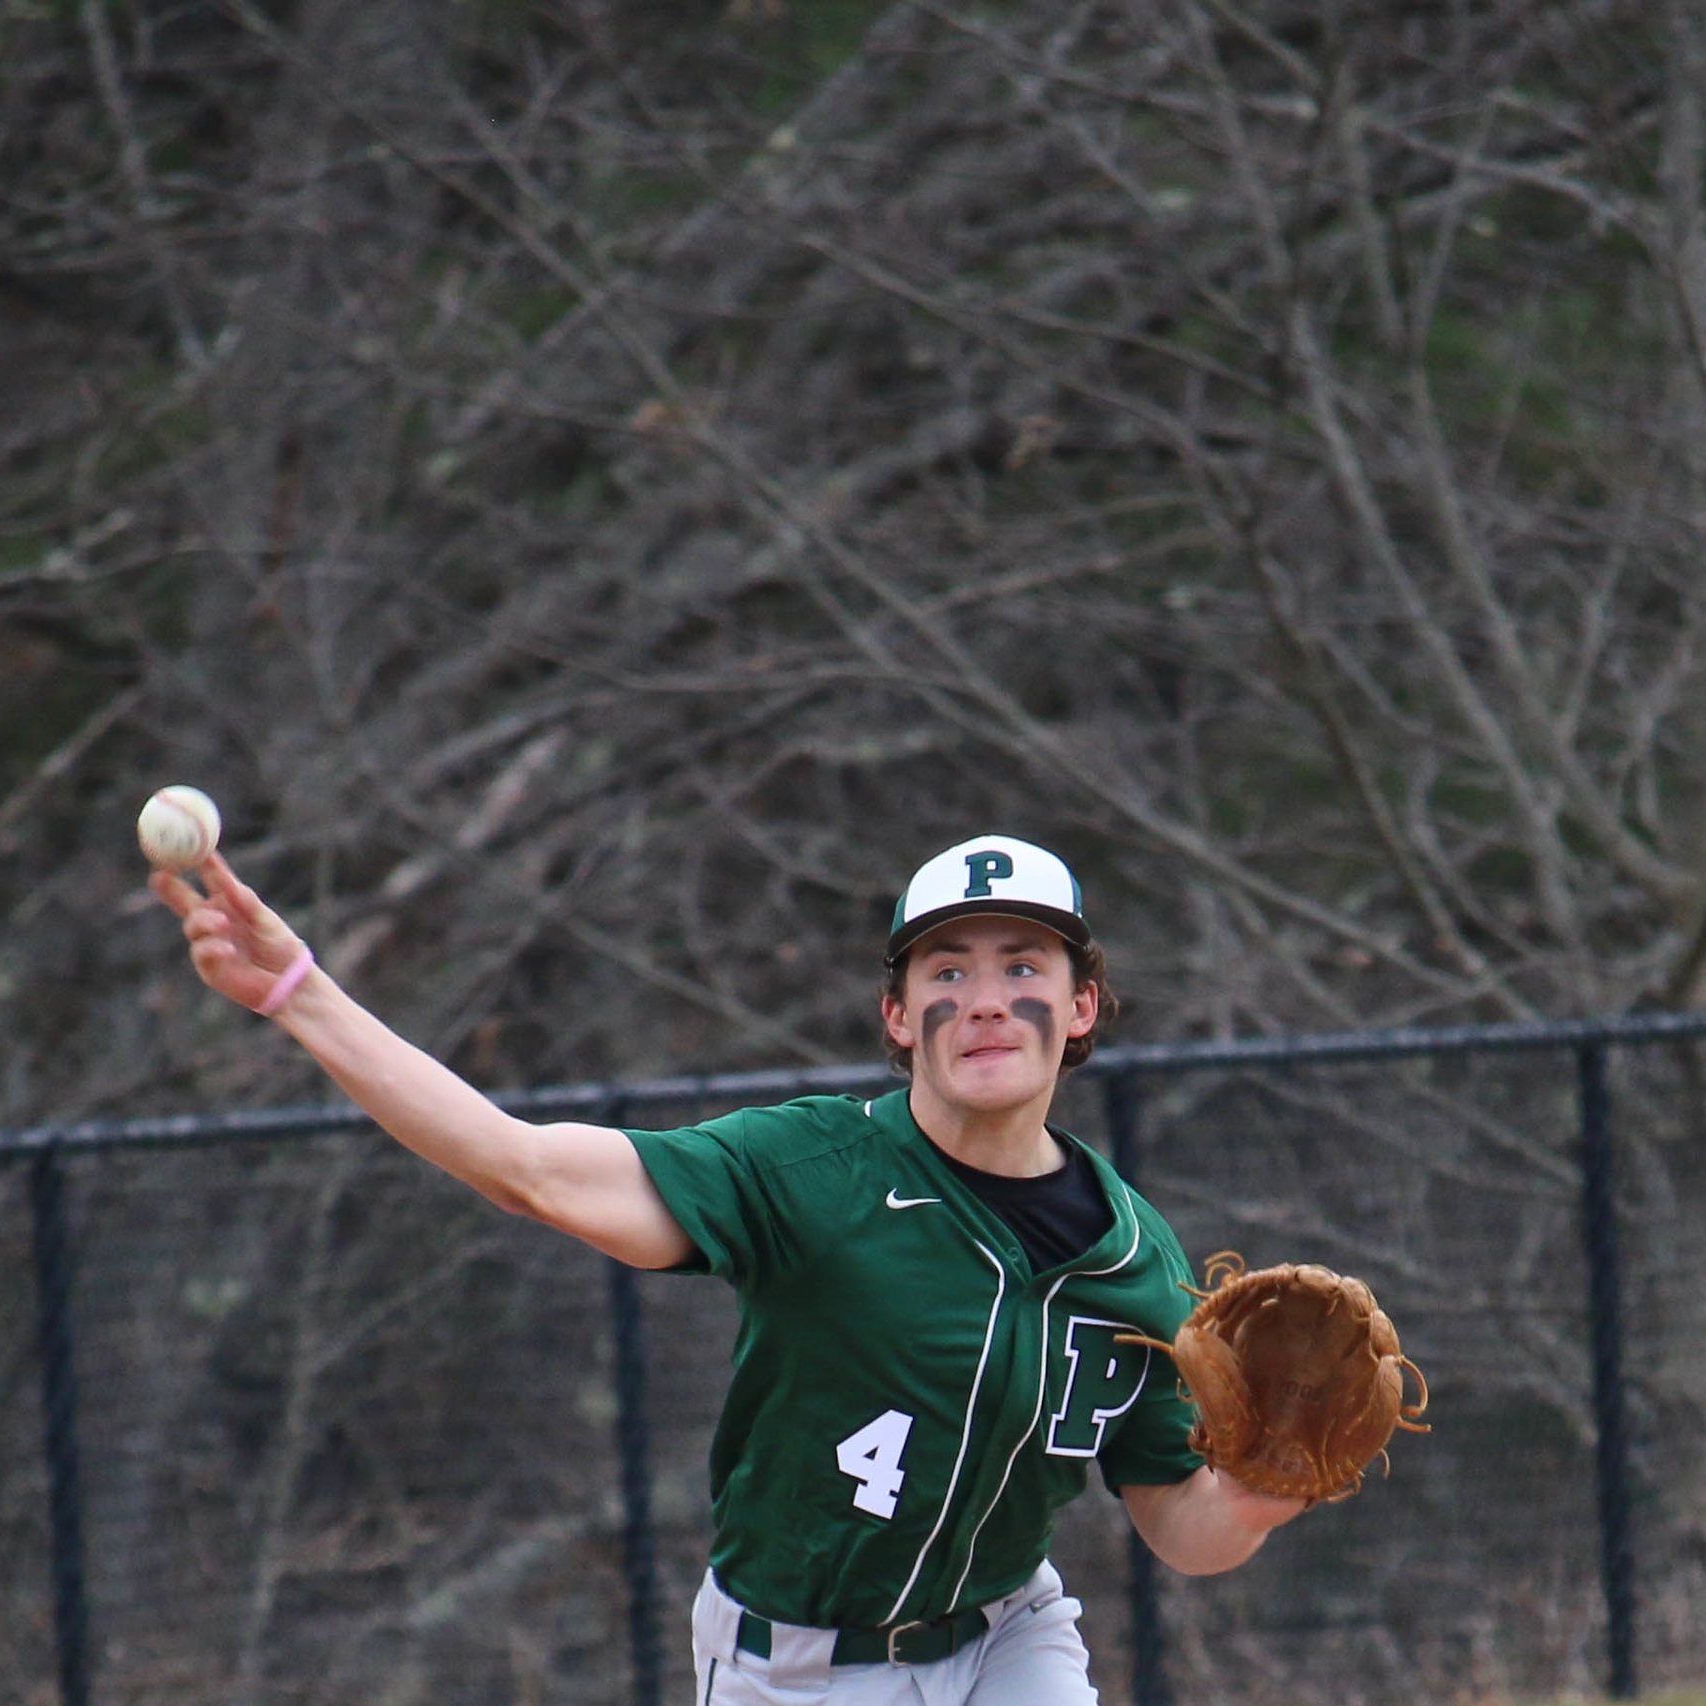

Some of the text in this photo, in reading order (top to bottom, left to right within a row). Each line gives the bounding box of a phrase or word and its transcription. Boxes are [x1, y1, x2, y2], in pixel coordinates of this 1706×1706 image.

[964, 850, 1013, 898] P
[1045, 1316, 1150, 1457] P
[836, 1409, 913, 1519] 4
